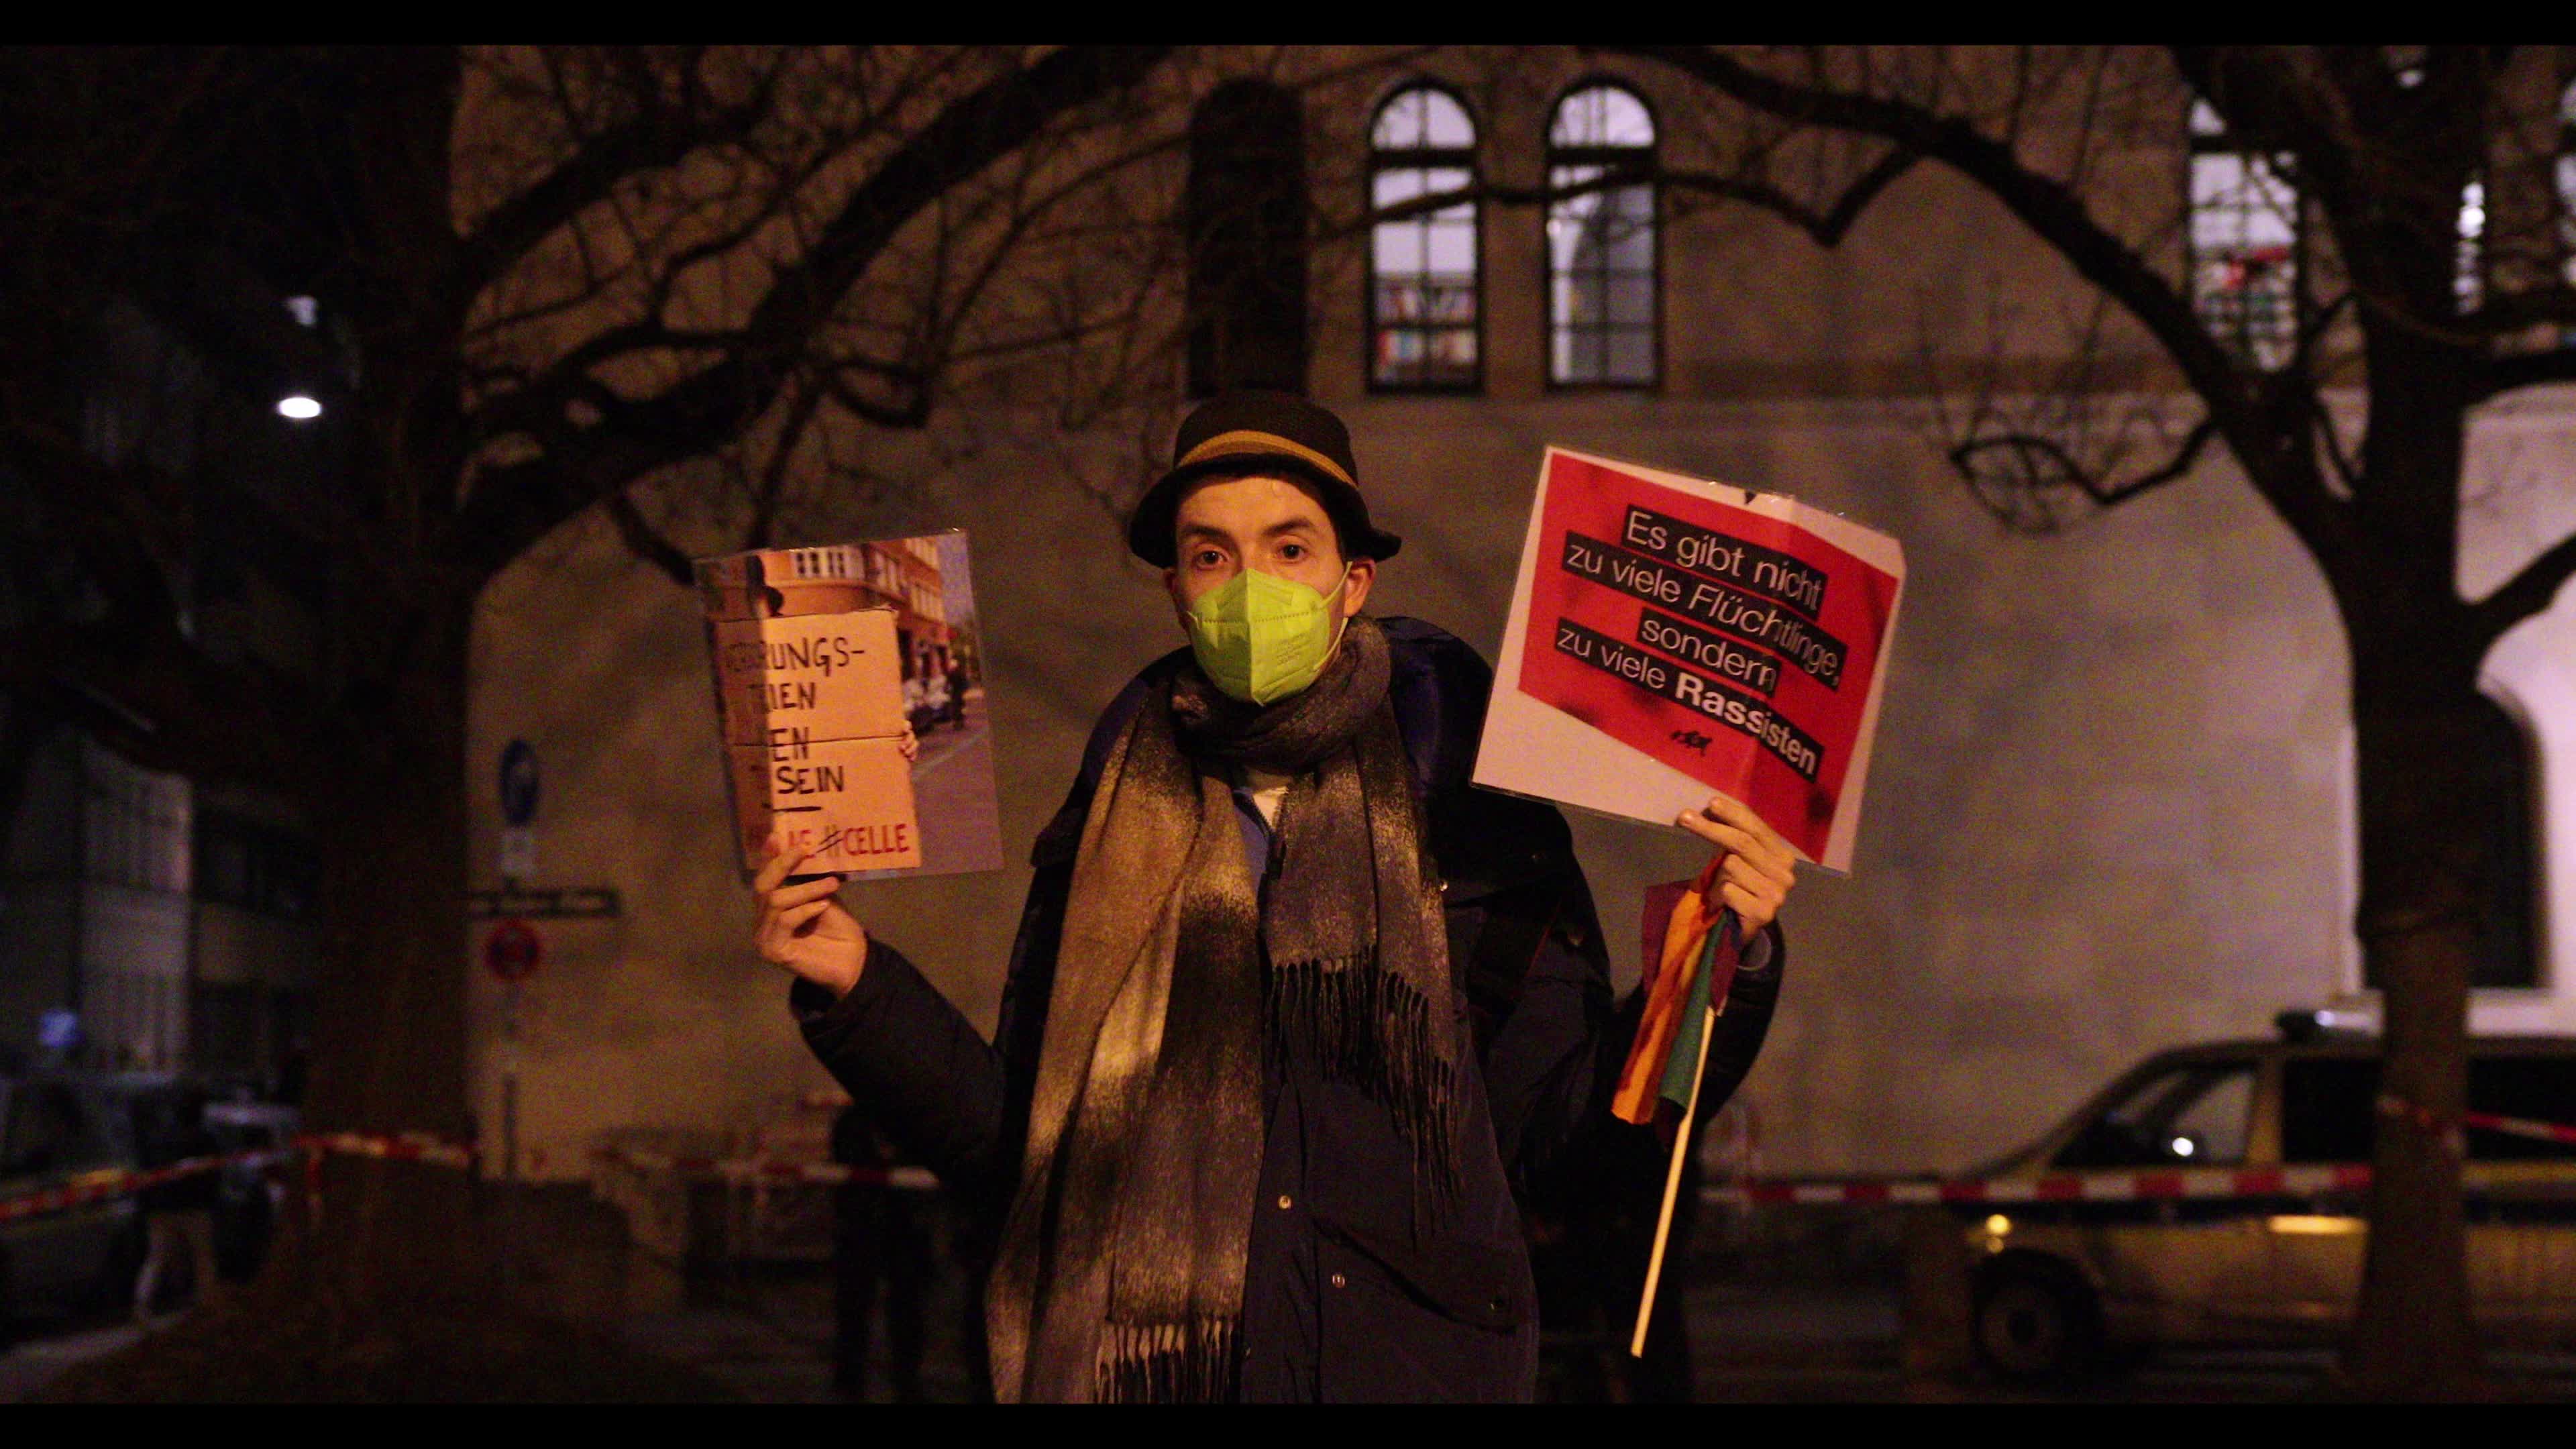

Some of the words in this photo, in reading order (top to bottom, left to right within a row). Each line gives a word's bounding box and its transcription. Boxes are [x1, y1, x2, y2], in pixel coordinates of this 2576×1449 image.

[1626, 511, 1668, 551] Es
[1676, 534, 1746, 578] gibt
[1754, 559, 1823, 611] nicht
[1567, 544, 1603, 574] zu
[1612, 558, 1681, 603] viele
[1688, 583, 1839, 687] Flüchtlinge,
[1642, 619, 1778, 692] sondern
[1557, 627, 1592, 658] zu
[1601, 644, 1666, 689] viele
[1675, 672, 1817, 775] Rassisten
[776, 765, 844, 794] SEIN
